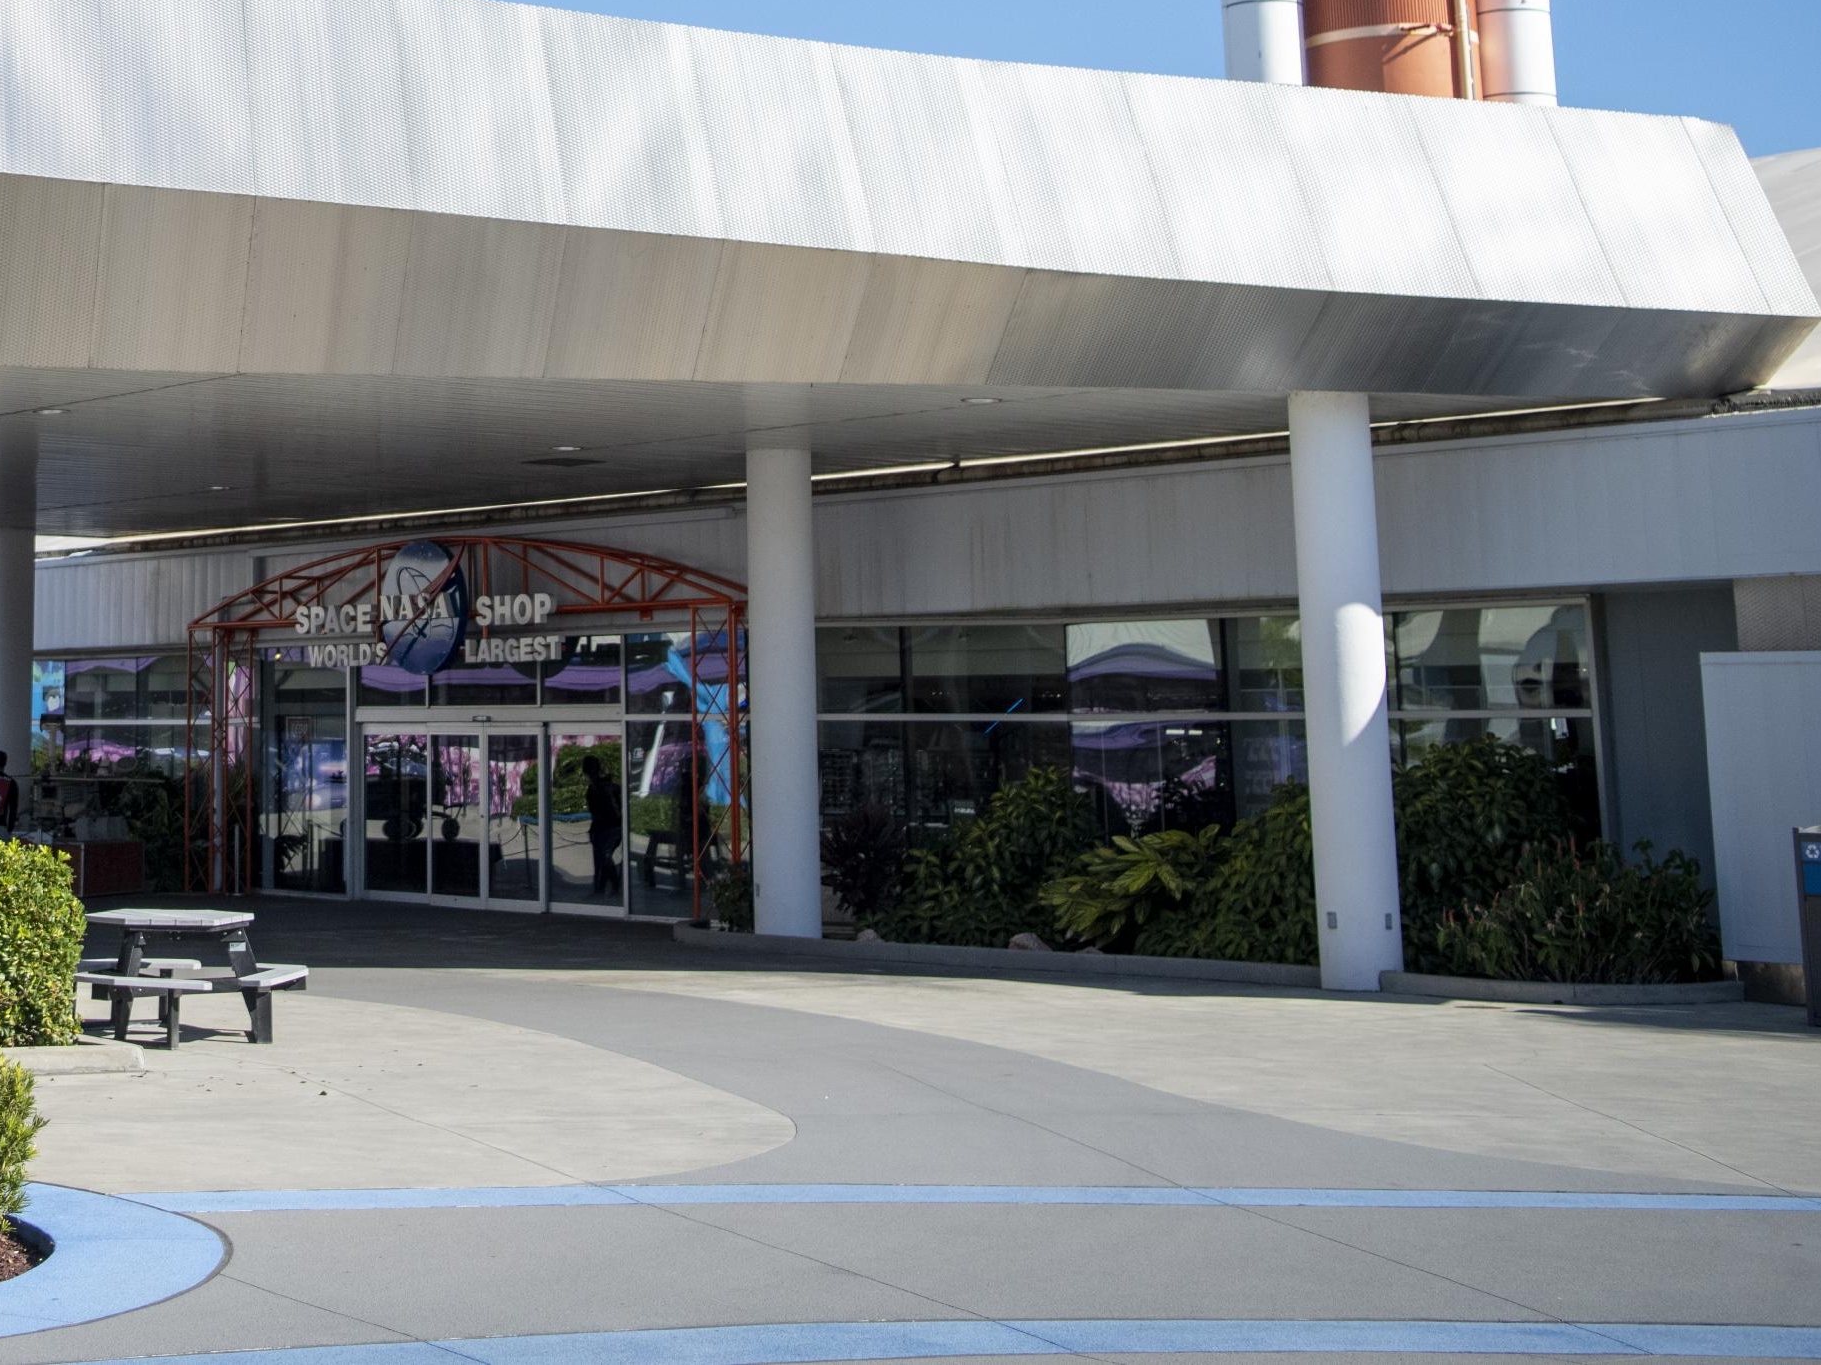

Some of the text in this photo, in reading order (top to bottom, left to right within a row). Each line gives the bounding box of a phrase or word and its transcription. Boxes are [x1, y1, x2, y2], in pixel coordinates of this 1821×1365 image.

[295, 593, 553, 634] SPACE SHOP
[380, 592, 450, 620] NASA
[308, 636, 561, 668] WORLD'S LARGEST
